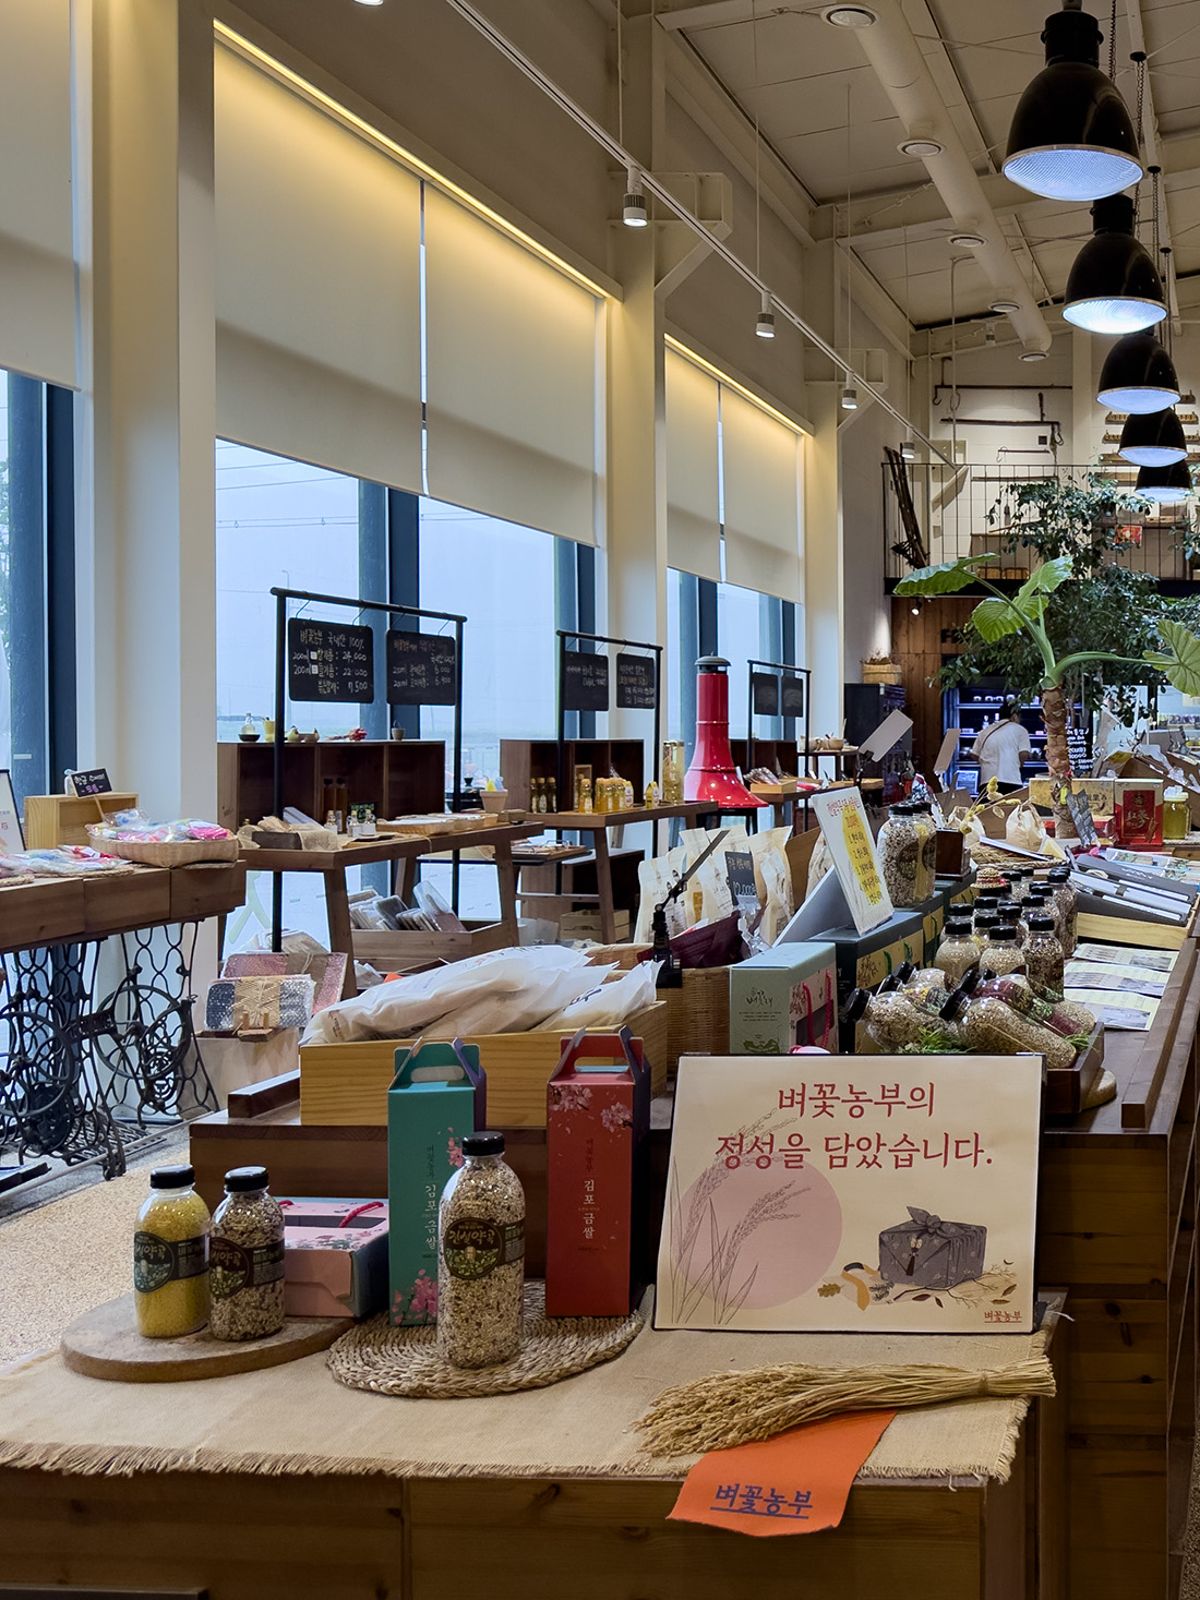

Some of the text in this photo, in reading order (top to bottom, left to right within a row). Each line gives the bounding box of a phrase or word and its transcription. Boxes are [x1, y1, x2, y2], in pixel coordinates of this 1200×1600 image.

[777, 1081, 936, 1119] 벼꽃농부의
[714, 1131, 994, 1170] 정성을 담았습니다.
[983, 1309, 1023, 1323] 벼꽃농부
[714, 1482, 814, 1516] 벼꽃농부
